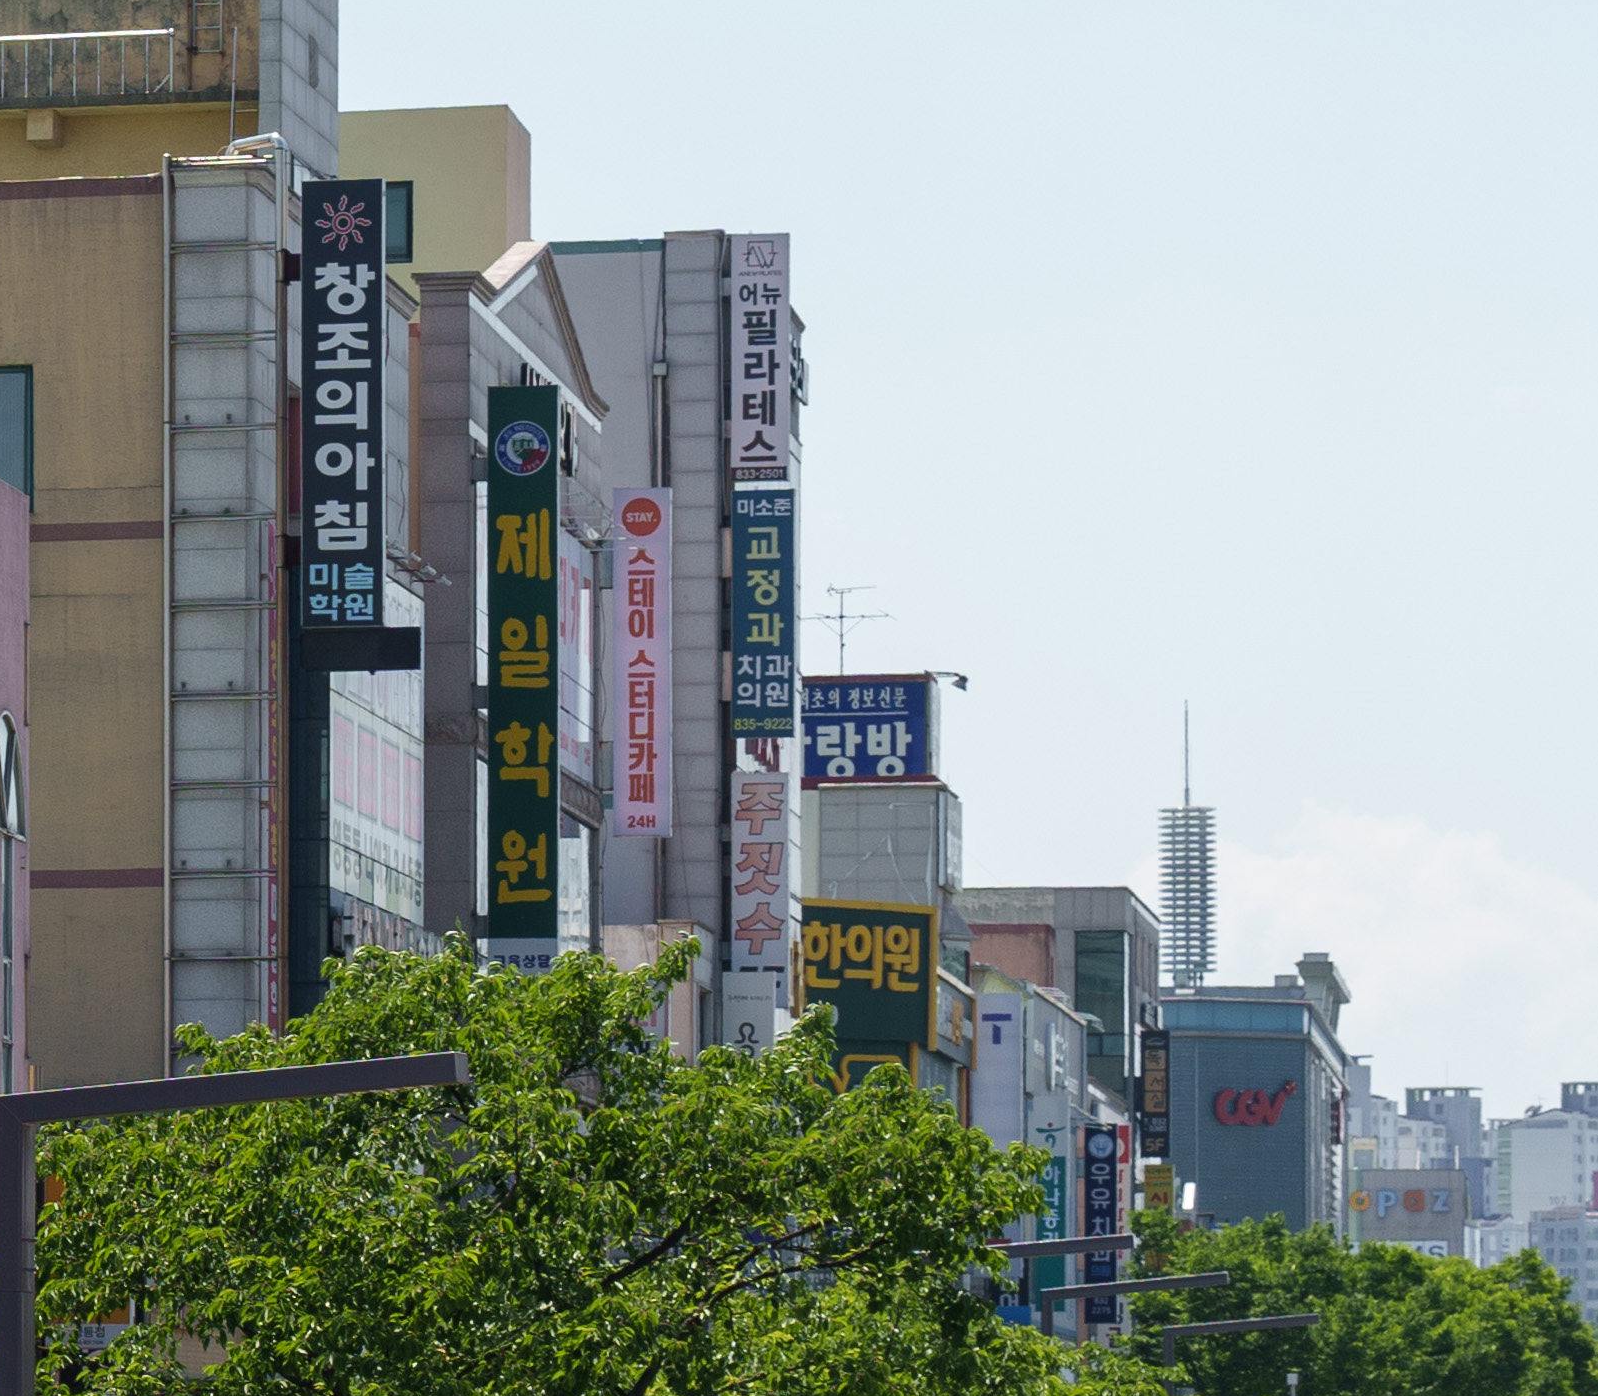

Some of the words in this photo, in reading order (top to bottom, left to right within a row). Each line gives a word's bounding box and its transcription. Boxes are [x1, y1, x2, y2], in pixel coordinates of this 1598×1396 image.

[739, 282, 782, 306] 어뉴
[740, 308, 780, 462] 필라테스
[314, 262, 376, 552] 창조의아침
[735, 468, 785, 481] 833-2501
[736, 498, 793, 518] 미소준
[309, 562, 375, 591] 미술
[627, 548, 656, 640] 스테이
[745, 526, 785, 648] 교정과
[309, 593, 375, 622] 학원
[736, 653, 793, 681] 치과
[495, 507, 554, 904] 제일학원
[736, 681, 791, 708] 의원
[847, 686, 908, 710] 정보신문
[627, 649, 658, 805] 스터디카페
[733, 717, 793, 733] 835-9222
[804, 720, 913, 777] 랑방
[627, 815, 657, 830] 24H
[734, 782, 786, 956] 주짓수
[805, 920, 921, 993] 한의원
[1213, 1086, 1285, 1127] CGV
